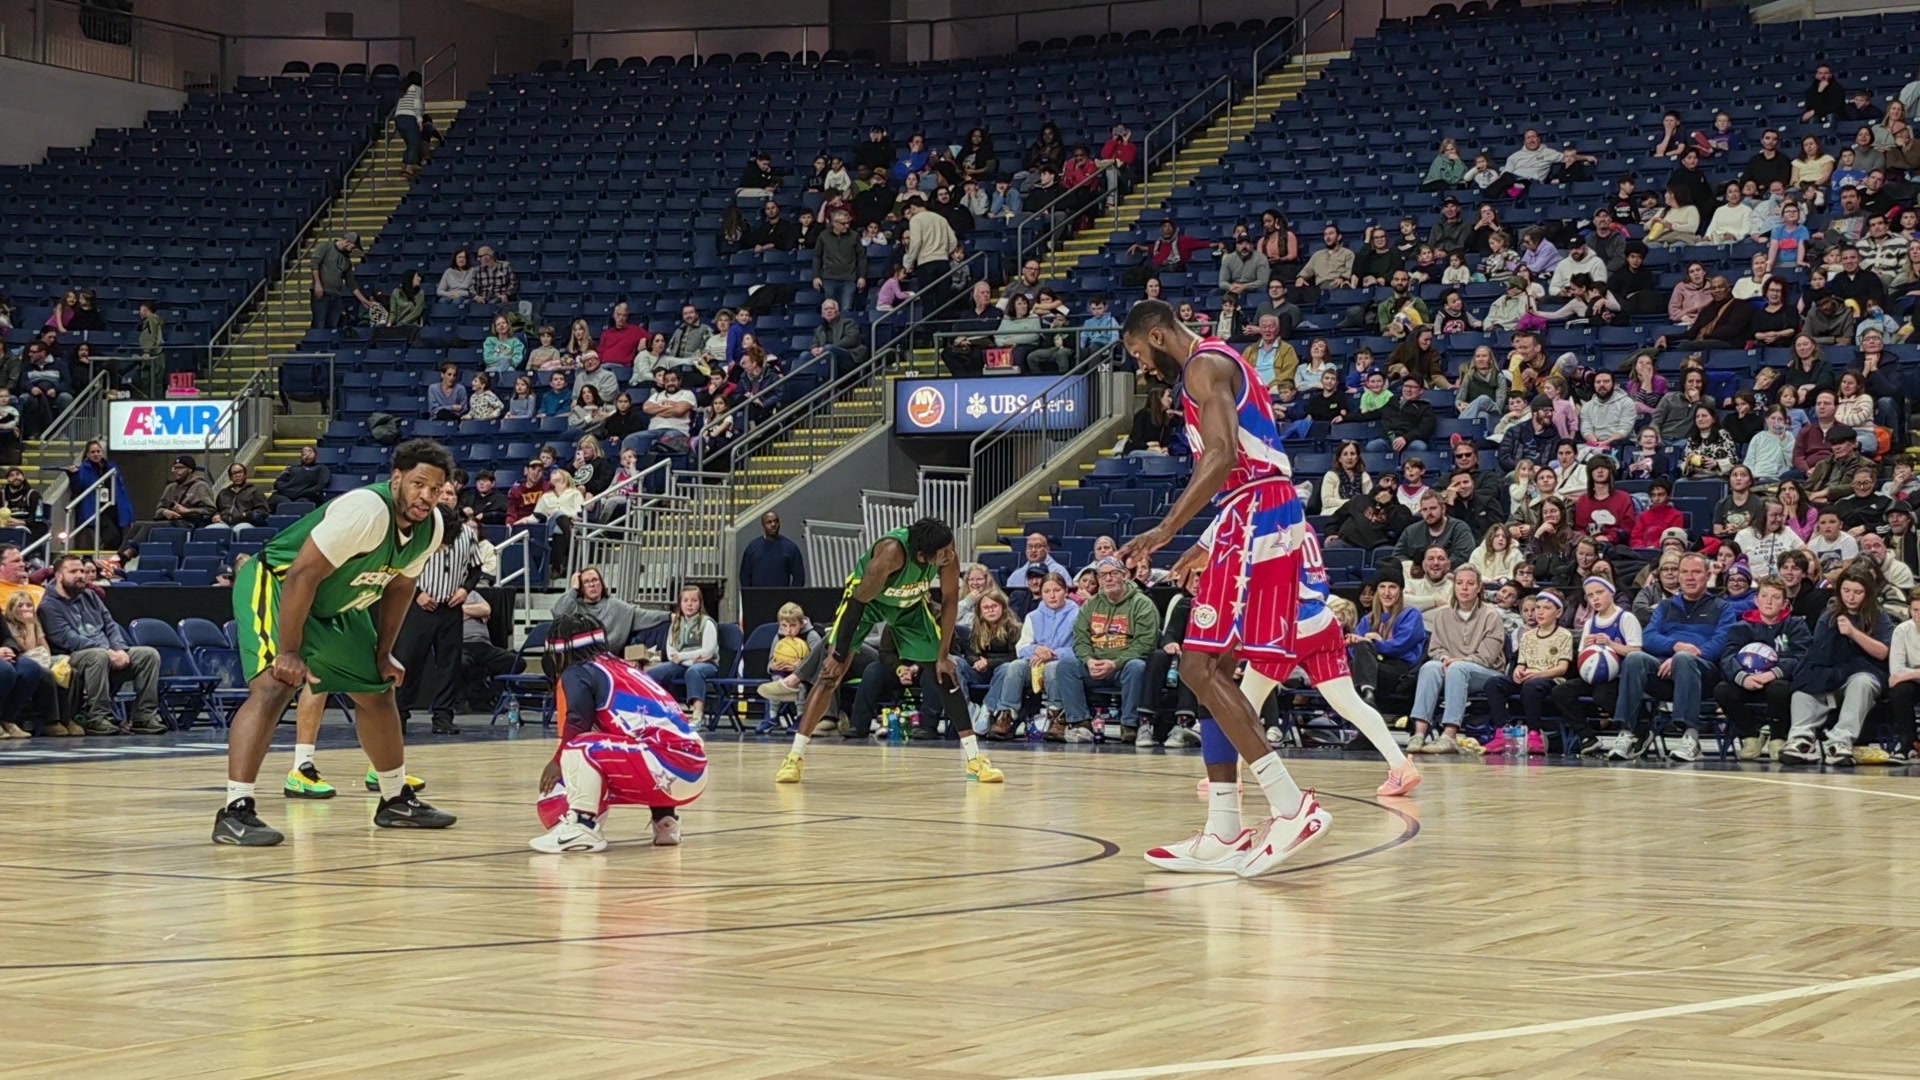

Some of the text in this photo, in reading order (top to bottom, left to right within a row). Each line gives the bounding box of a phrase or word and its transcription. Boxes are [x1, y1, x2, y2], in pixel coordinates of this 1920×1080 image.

[170, 372, 194, 389] EXIT
[990, 394, 1074, 414] UBS Aena
[123, 405, 221, 436] AMR
[128, 438, 147, 447] Global
[148, 438, 171, 447] Medical
